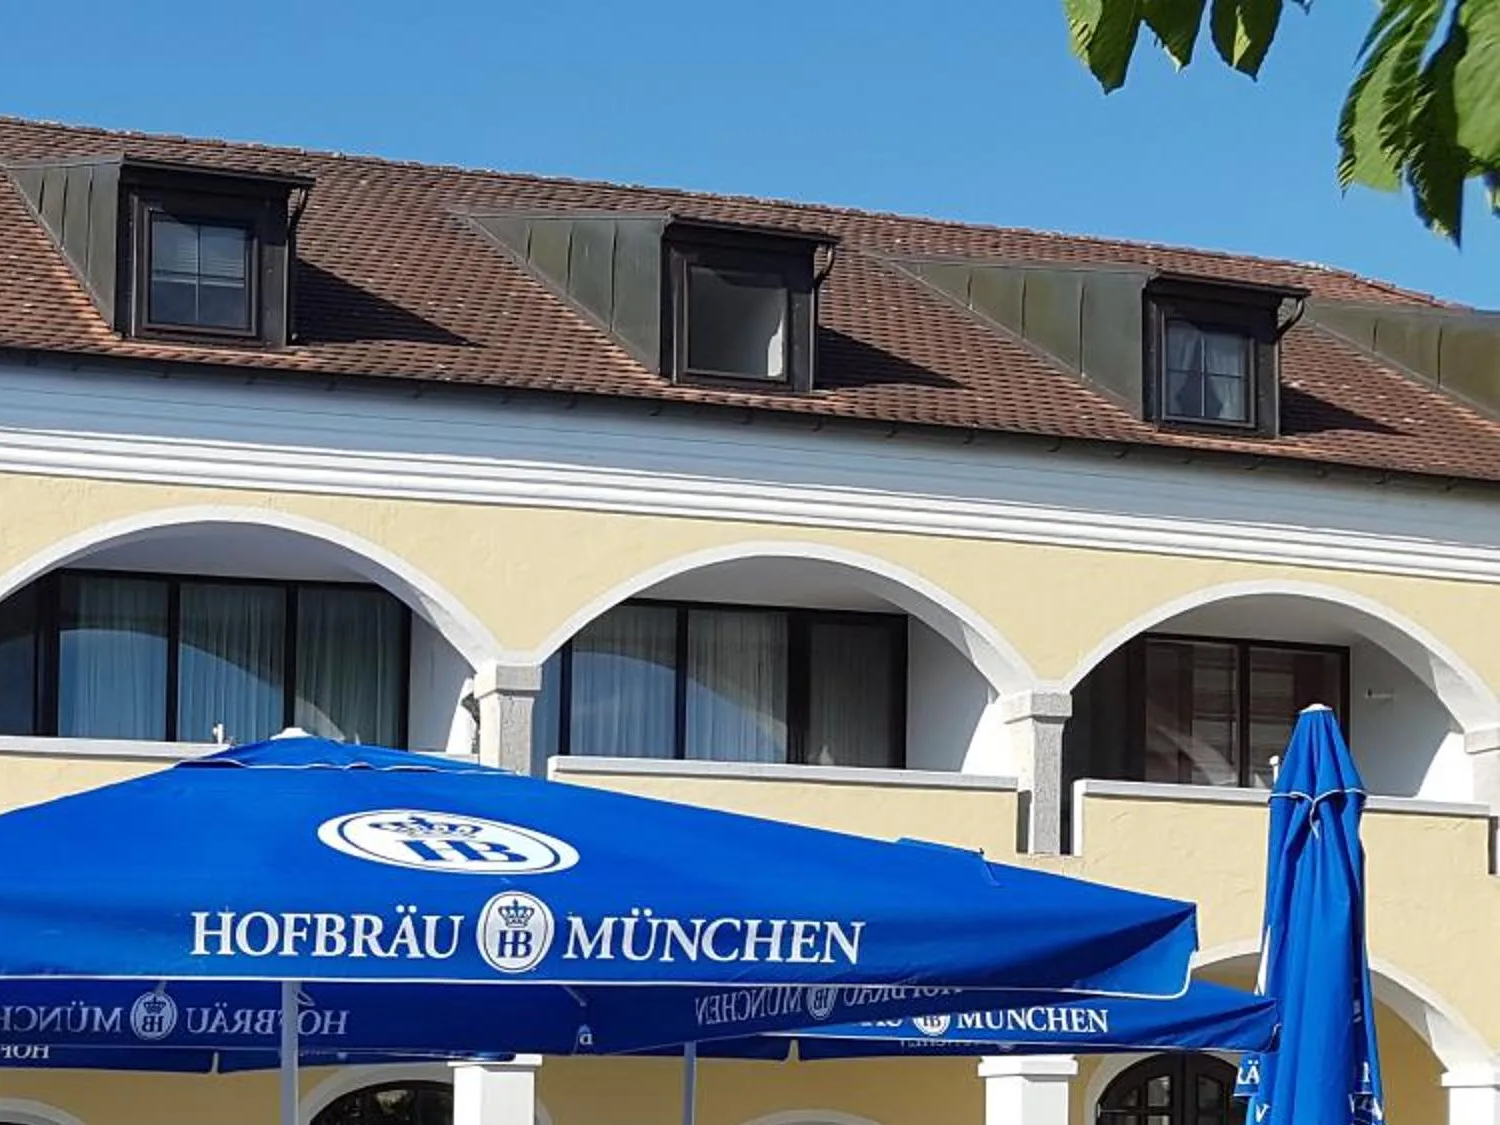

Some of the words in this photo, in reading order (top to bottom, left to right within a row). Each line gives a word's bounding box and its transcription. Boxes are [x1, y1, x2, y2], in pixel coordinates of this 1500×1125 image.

[191, 905, 464, 959] HOFBRÄU
[496, 929, 535, 959] HB
[563, 907, 866, 965] MÜNCHEN
